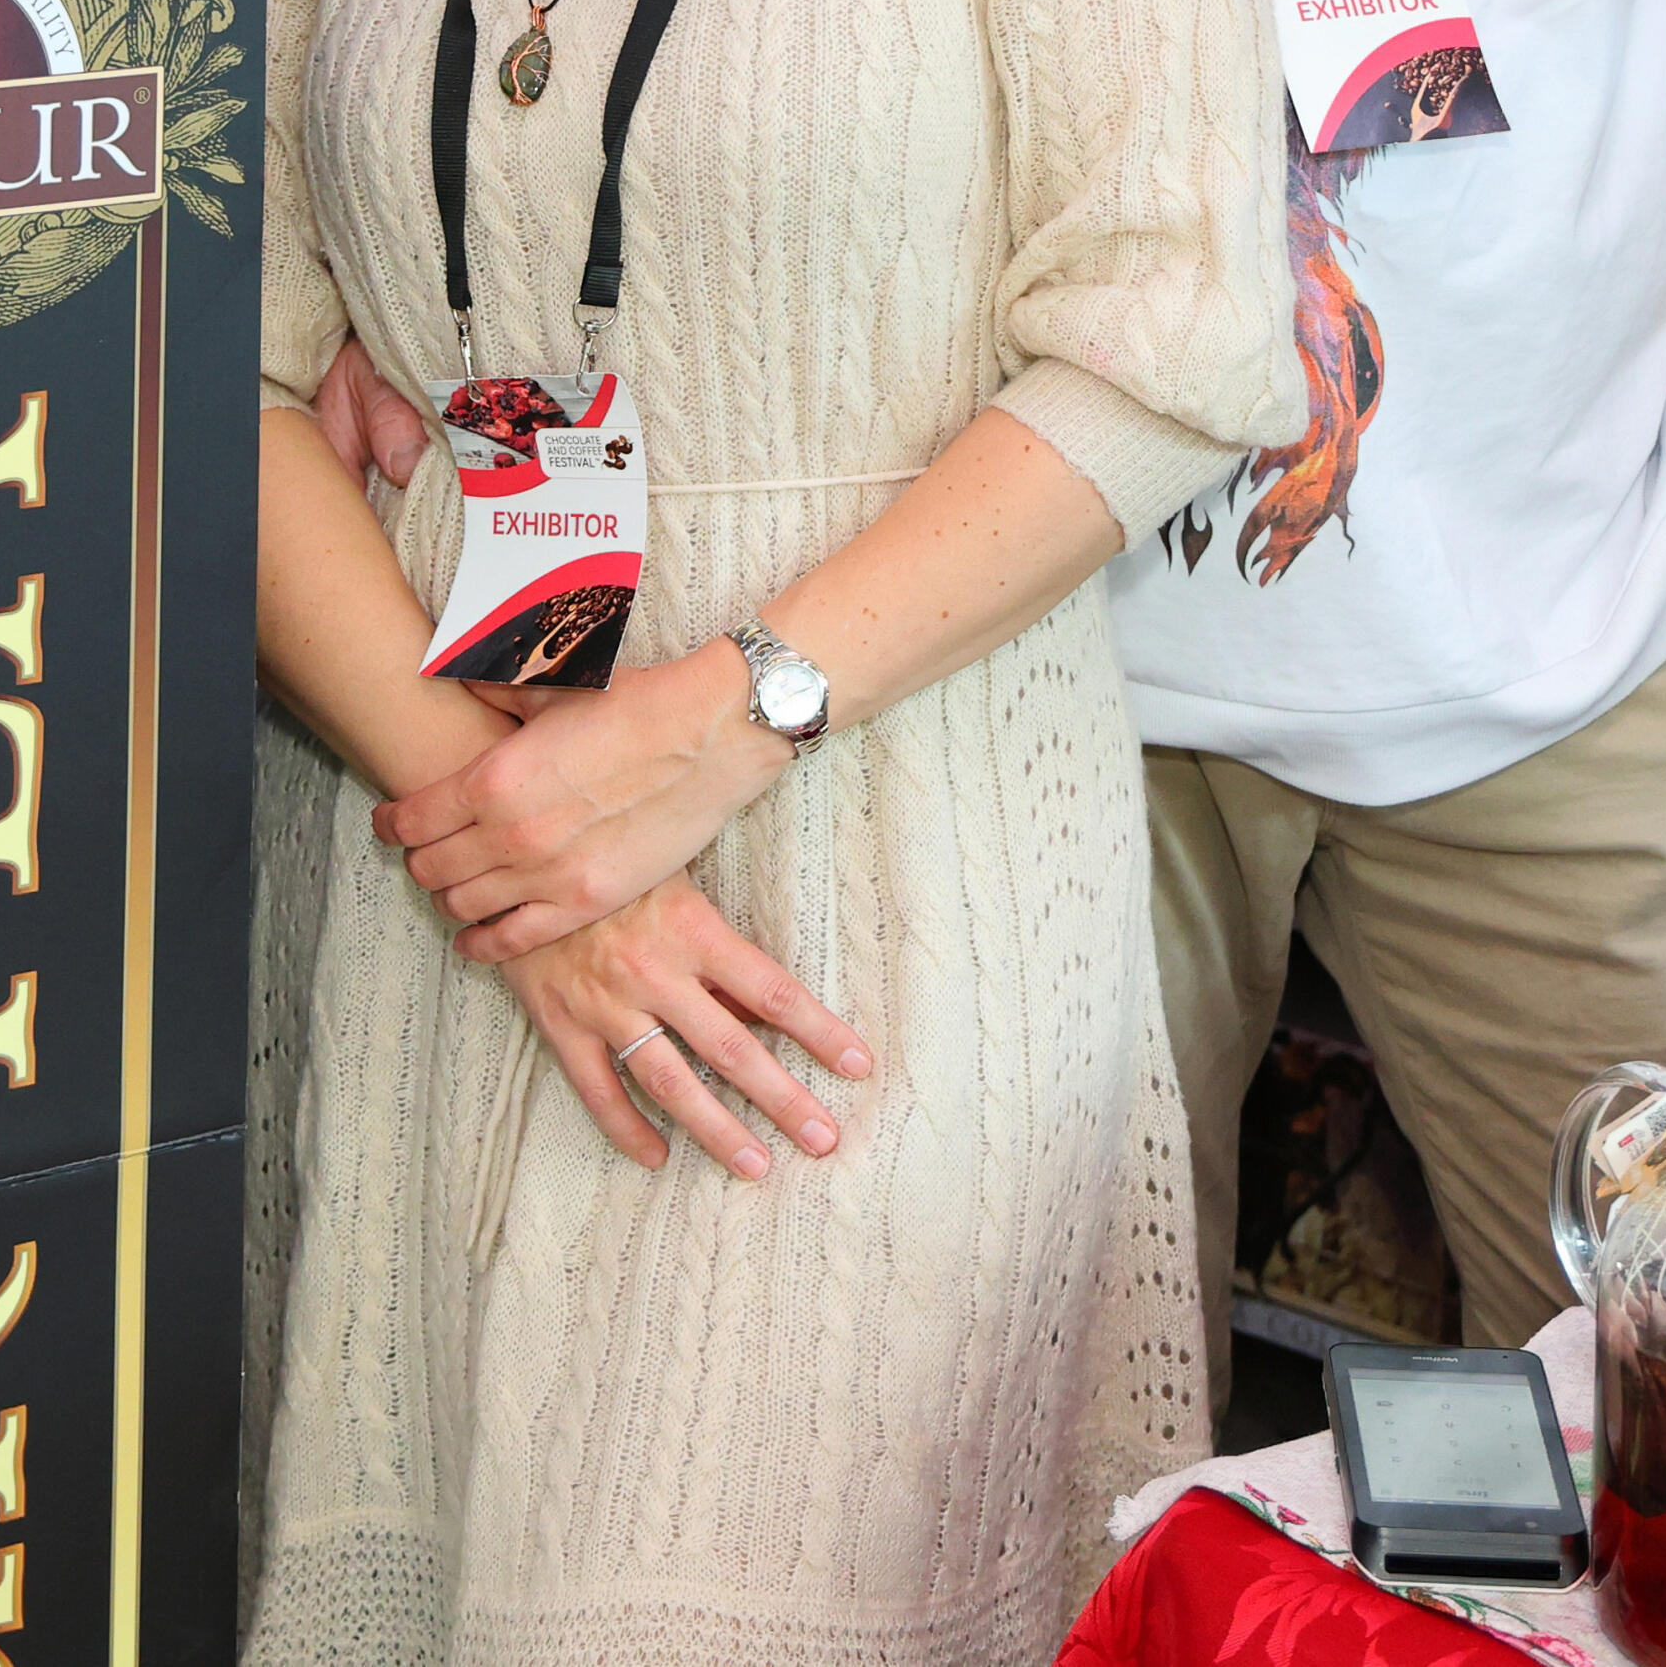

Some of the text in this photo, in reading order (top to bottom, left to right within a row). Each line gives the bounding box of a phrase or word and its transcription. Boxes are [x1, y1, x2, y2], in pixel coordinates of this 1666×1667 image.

[544, 434, 603, 448] CHOCOLATE
[547, 445, 604, 457] AND COFFEE
[492, 511, 620, 540] EXHIBITOR
